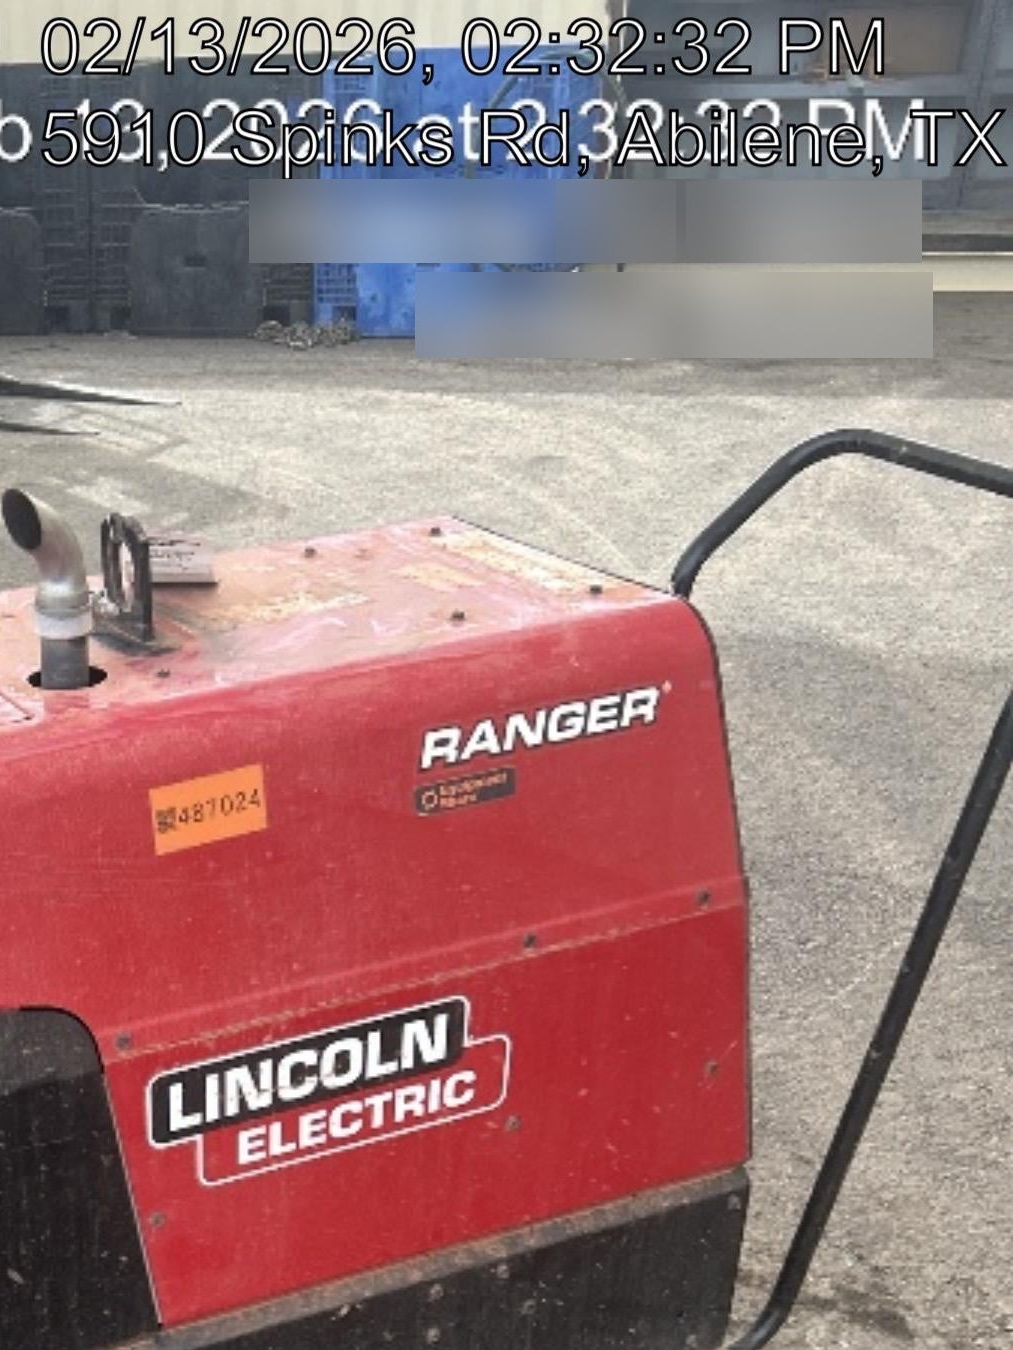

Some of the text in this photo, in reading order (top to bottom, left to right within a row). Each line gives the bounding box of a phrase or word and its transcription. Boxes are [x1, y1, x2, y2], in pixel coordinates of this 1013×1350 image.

[419, 685, 661, 769] RANGER
[178, 788, 261, 824] 487024
[168, 1013, 450, 1132] LINCOLN
[237, 1069, 477, 1166] ELECTRIC
